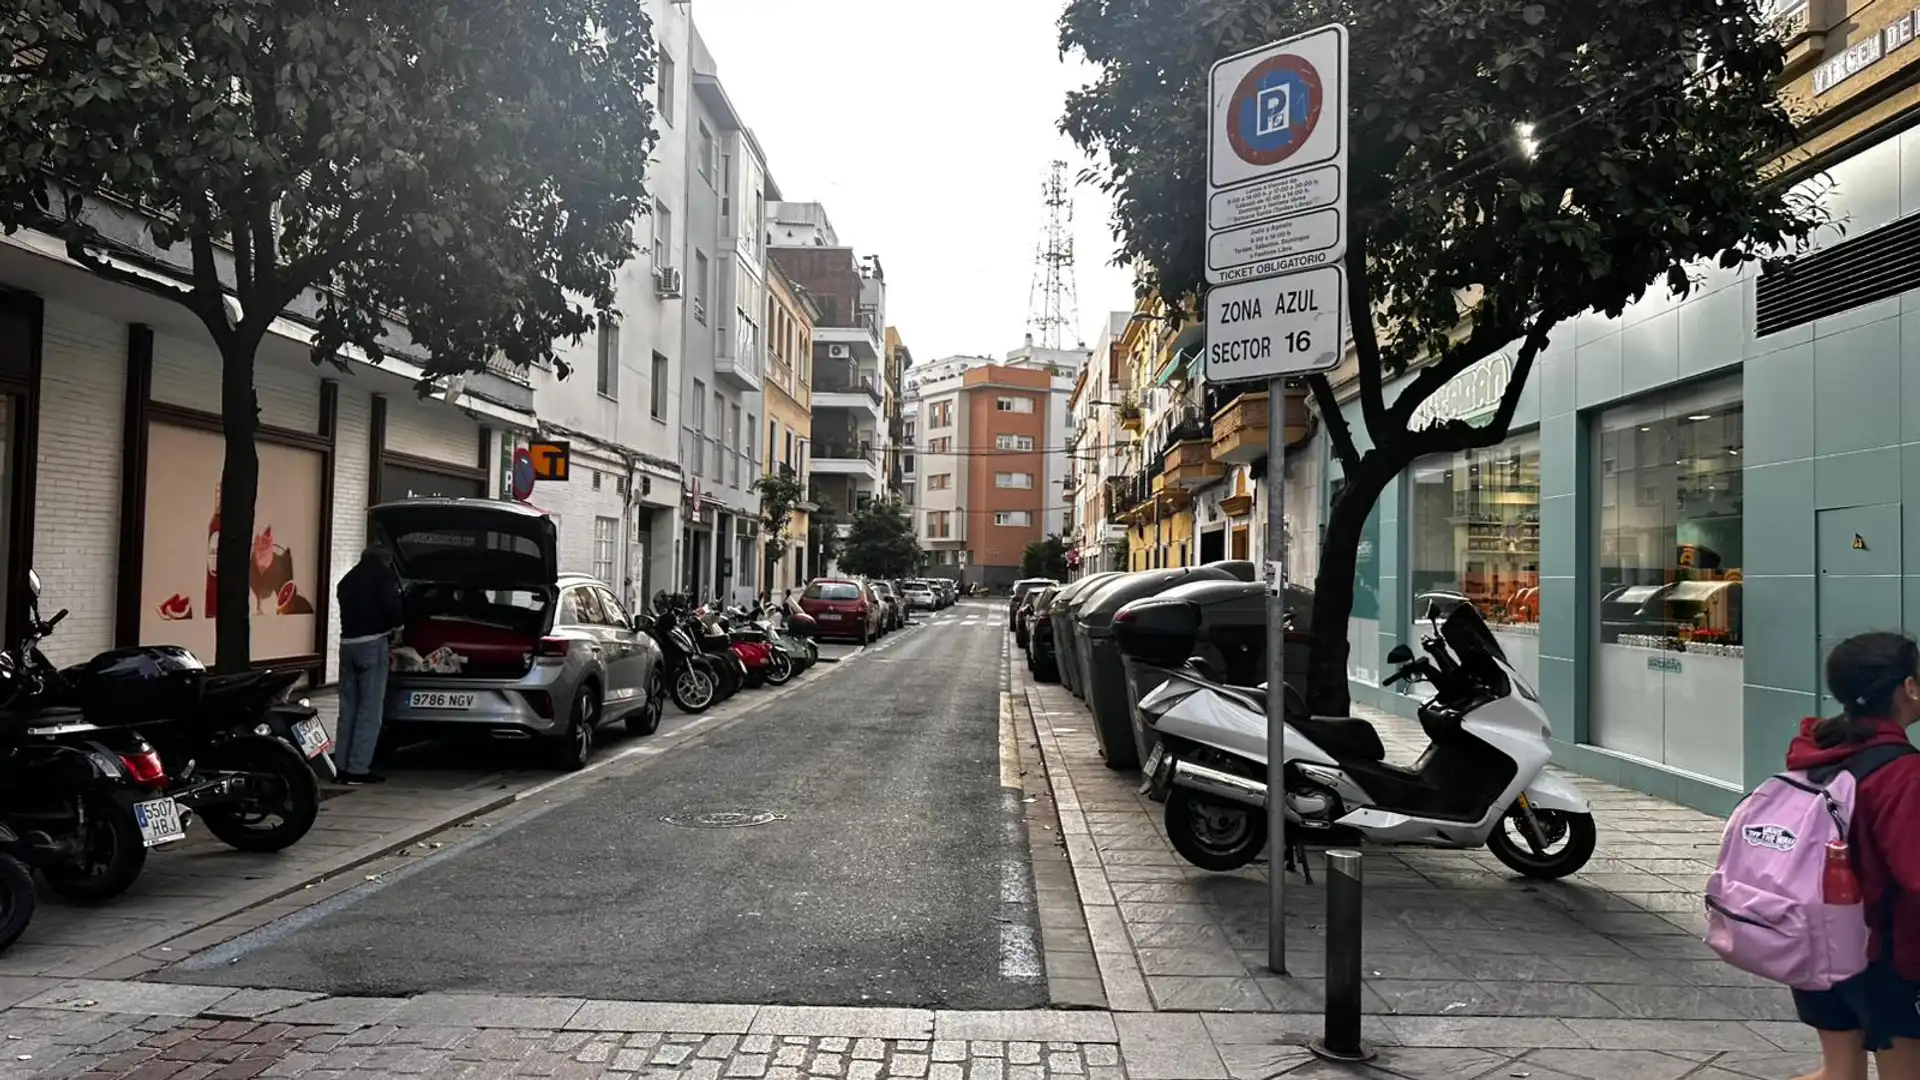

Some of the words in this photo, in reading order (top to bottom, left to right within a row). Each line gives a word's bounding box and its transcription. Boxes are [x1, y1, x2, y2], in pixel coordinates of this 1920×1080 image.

[1813, 34, 1880, 92] VIRGEN
[1886, 16, 1911, 53] DE
[1220, 266, 1254, 281] TICKET
[1256, 252, 1326, 274] OBLIGATORIO
[1221, 298, 1262, 324] ZONA
[1275, 289, 1318, 315] AZUL
[1212, 336, 1271, 364] SECTOR
[1285, 330, 1311, 353] 16
[412, 694, 445, 706] 9786
[448, 695, 474, 706] NGV
[144, 800, 172, 819] 5507
[152, 818, 176, 836] HBJ
